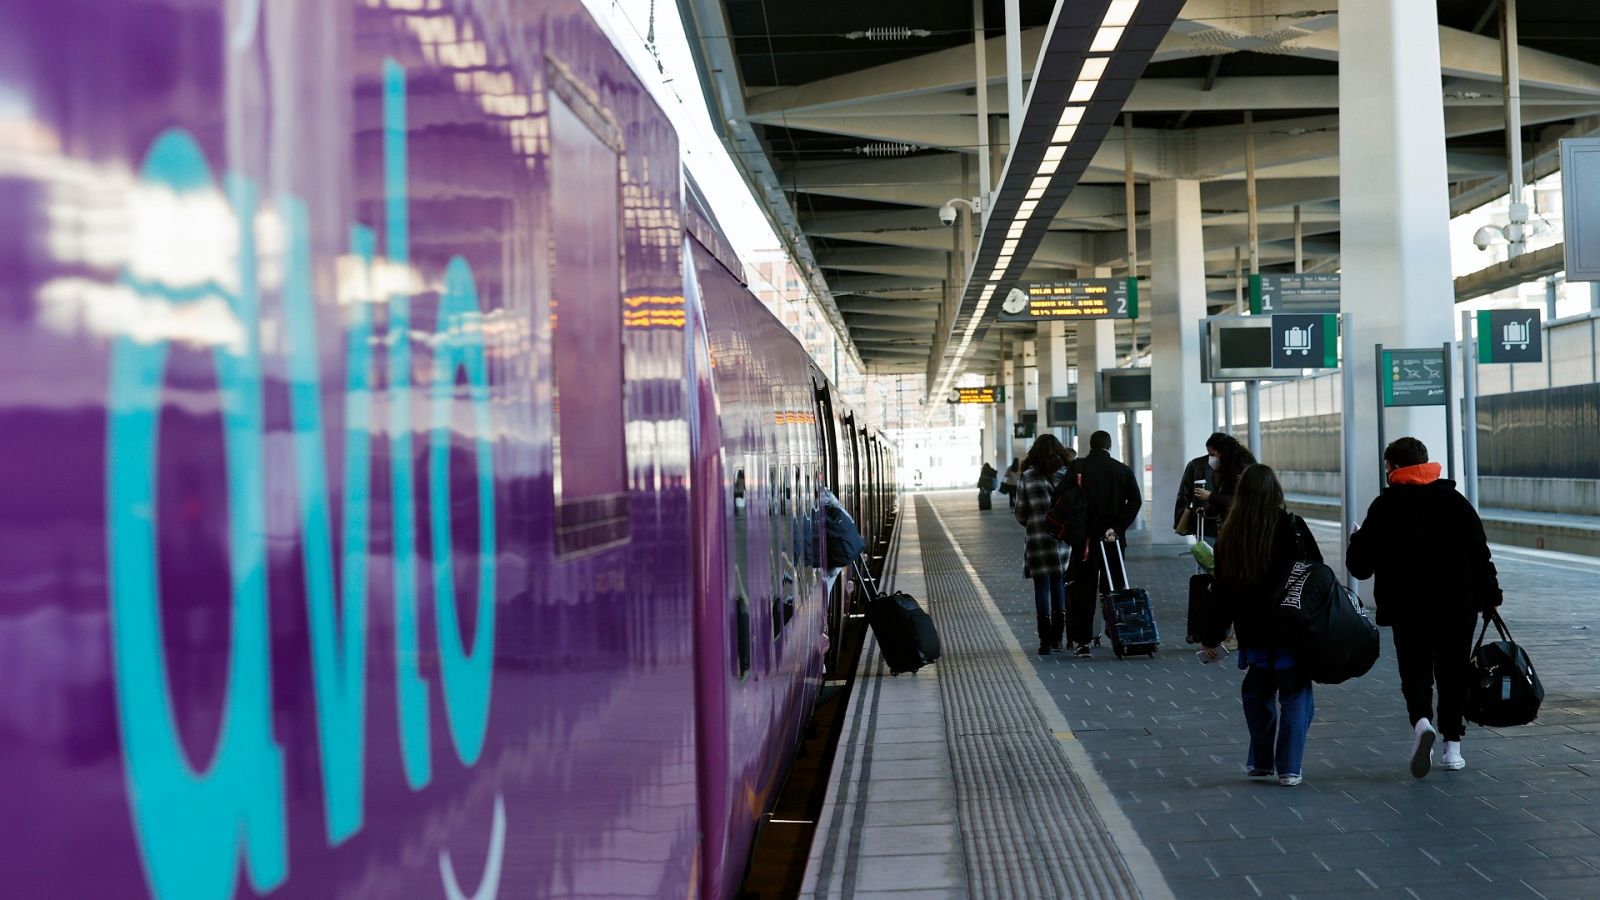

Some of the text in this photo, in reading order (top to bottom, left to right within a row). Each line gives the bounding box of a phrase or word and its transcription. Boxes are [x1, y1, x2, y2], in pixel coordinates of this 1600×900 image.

[1117, 298, 1127, 314] 2
[1262, 294, 1274, 311] 1
[107, 58, 497, 900] avlo
